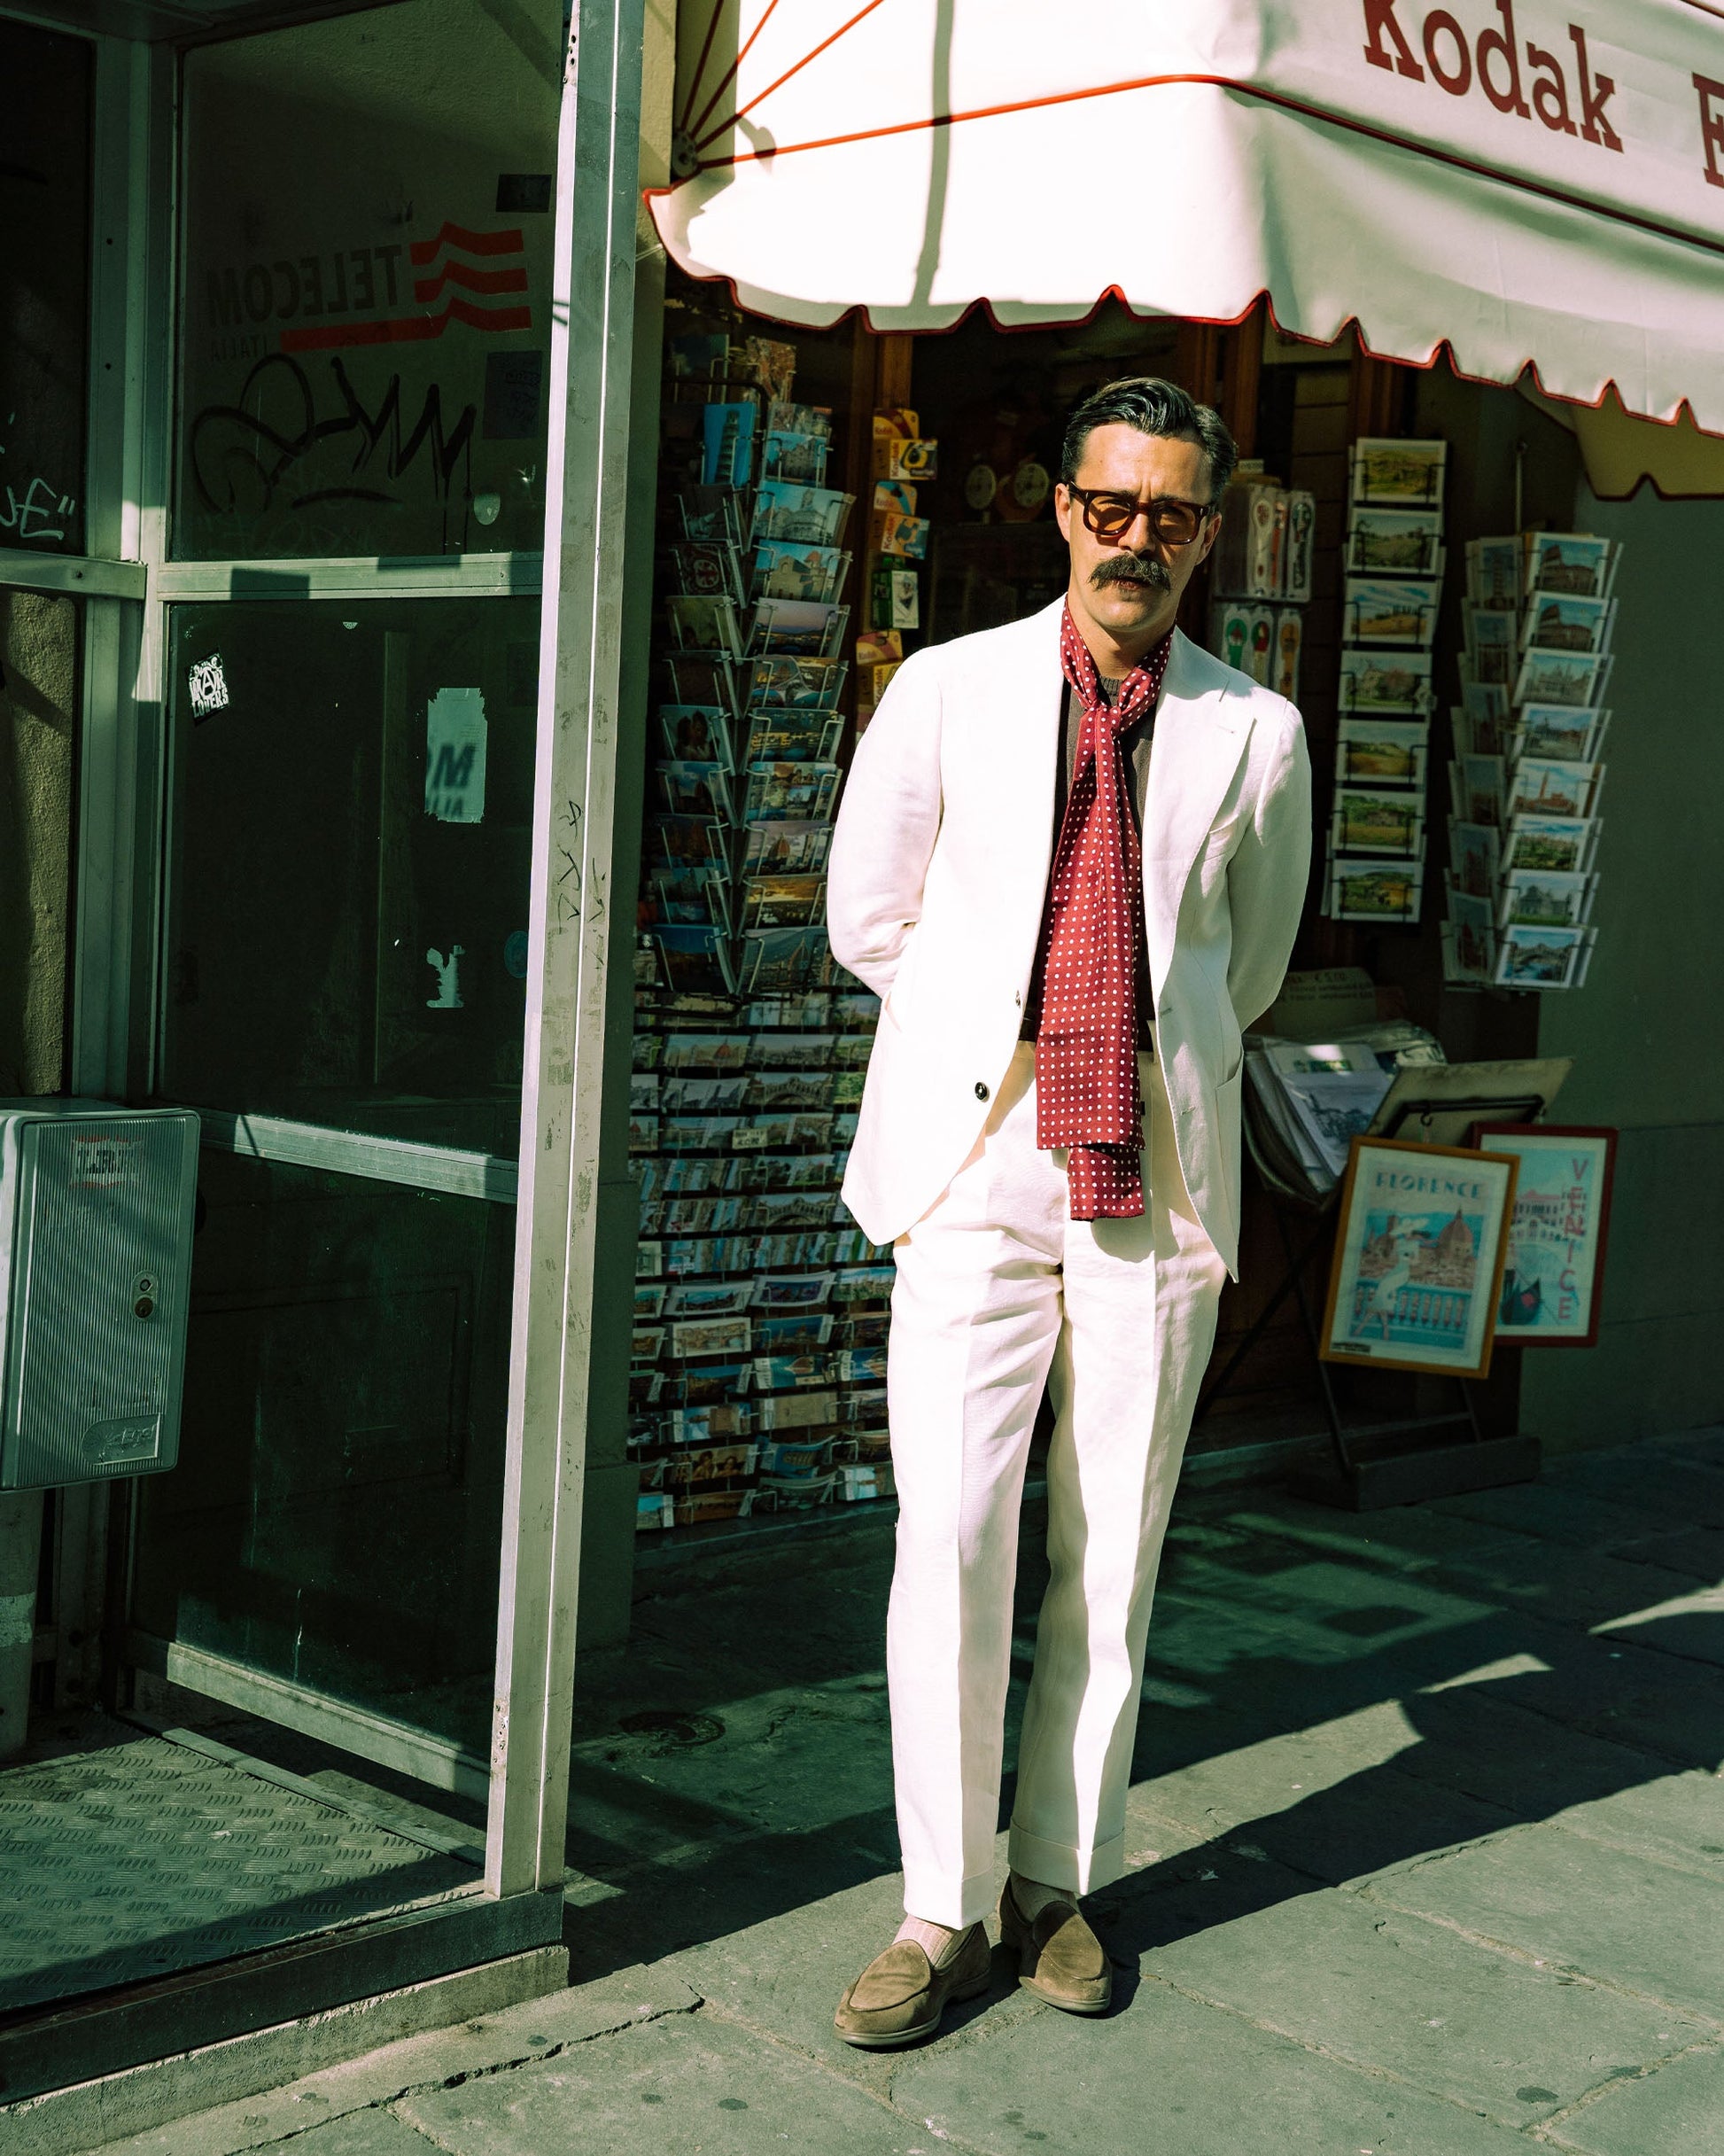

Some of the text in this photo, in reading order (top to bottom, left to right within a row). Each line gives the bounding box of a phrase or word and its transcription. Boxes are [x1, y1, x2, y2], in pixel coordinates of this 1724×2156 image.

[1363, 0, 1625, 154] Kodak
[1375, 1171, 1483, 1199] FLORENCE
[1557, 1158, 1589, 1319] VENICE
